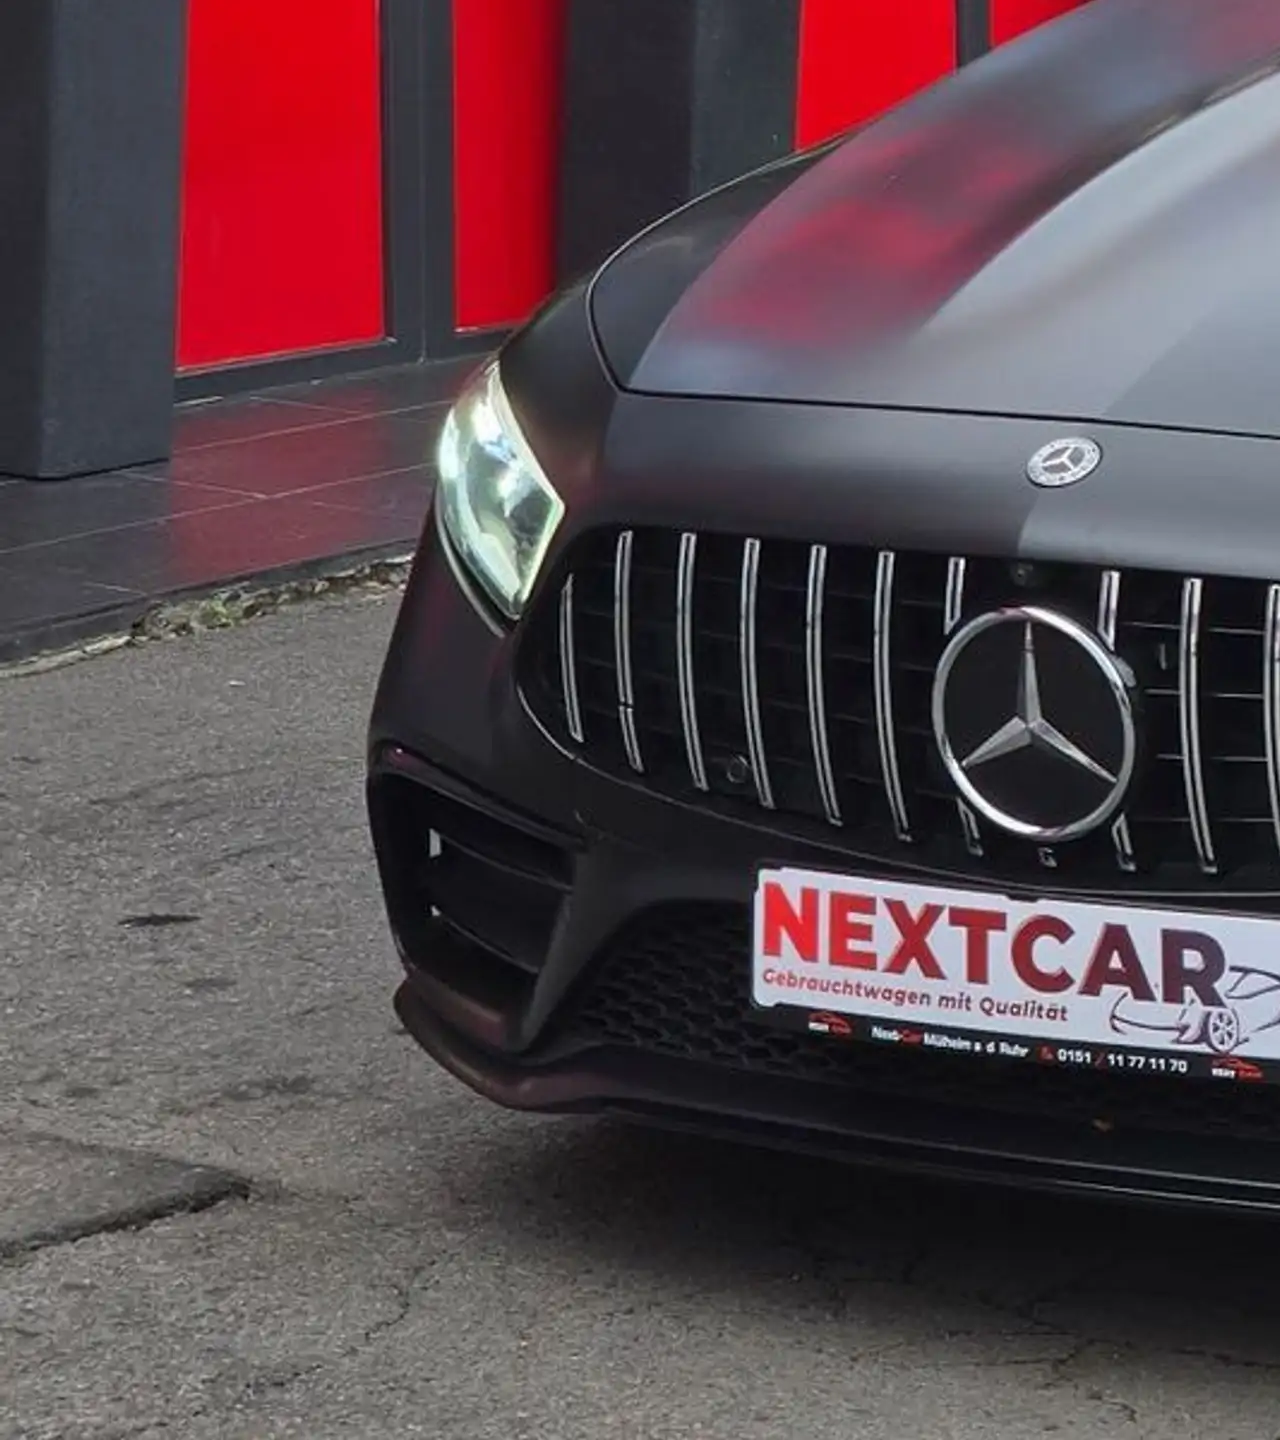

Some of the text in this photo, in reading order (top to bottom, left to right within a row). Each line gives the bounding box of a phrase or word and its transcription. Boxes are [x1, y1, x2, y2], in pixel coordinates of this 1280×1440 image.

[761, 881, 1230, 1007] NEXTCAR
[762, 967, 1068, 1022] Gebrauchtwagen mit Qualität
[1057, 1048, 1091, 1064] 0151
